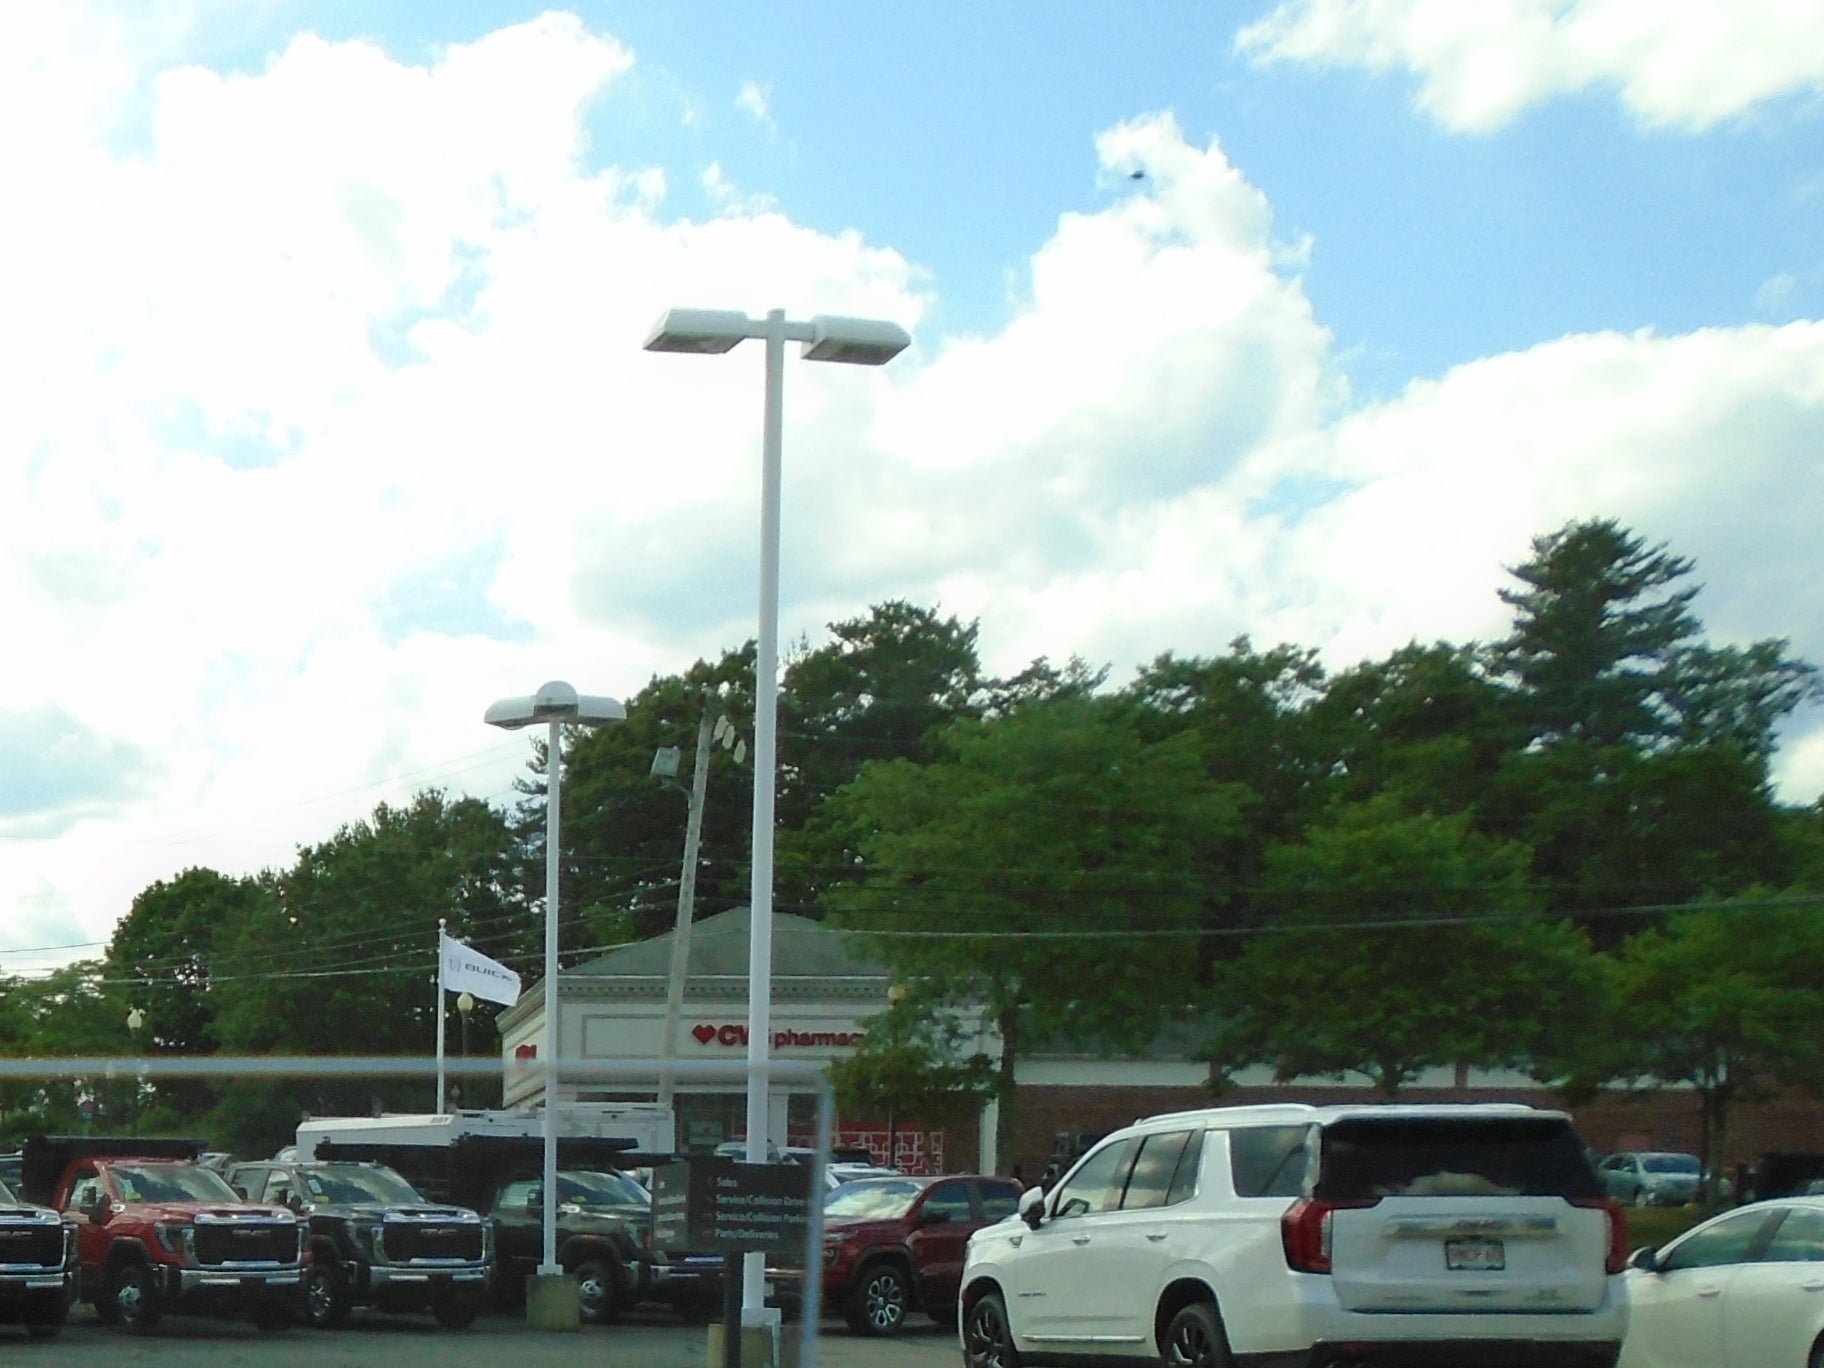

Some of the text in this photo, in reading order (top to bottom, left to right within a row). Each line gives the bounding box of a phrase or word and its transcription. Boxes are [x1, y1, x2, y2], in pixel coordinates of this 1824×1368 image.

[718, 1025, 866, 1049] CV pharmac
[716, 1177, 738, 1188] Sales
